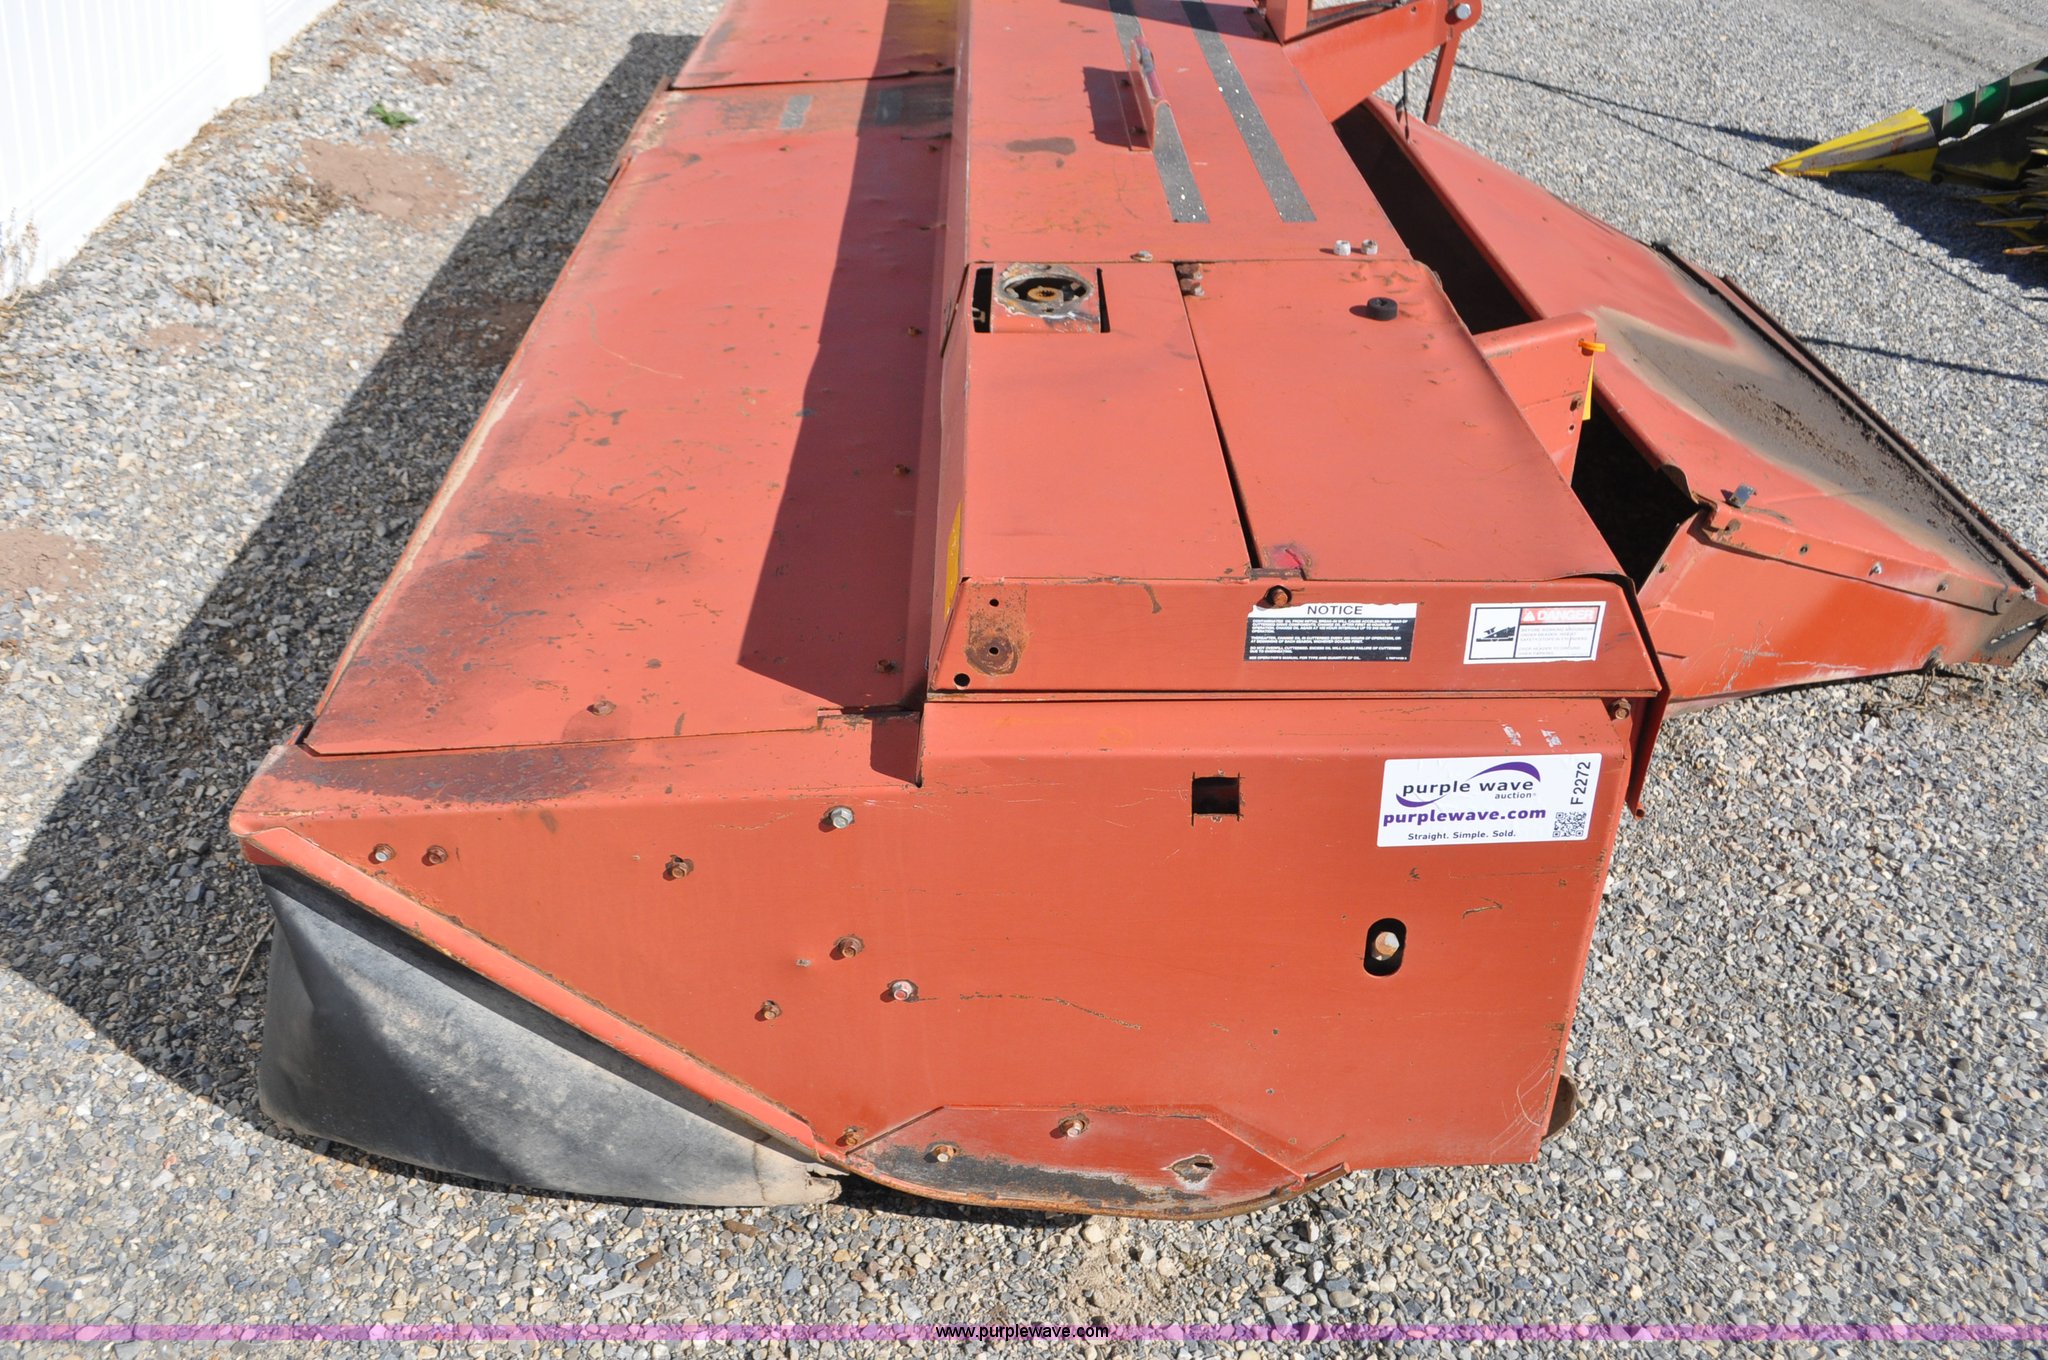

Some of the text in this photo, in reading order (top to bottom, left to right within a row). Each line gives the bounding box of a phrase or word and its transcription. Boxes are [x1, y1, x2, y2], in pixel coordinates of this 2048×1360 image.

[1307, 605, 1363, 615] NOTICE
[1538, 610, 1594, 620] DANGER
[1402, 780, 1534, 797] purple wave
[1570, 761, 1592, 805] F2272
[1494, 792, 1532, 800] auction
[1383, 809, 1546, 827] purplewave.com
[1408, 830, 1516, 842] Straight. Simple. Sold.
